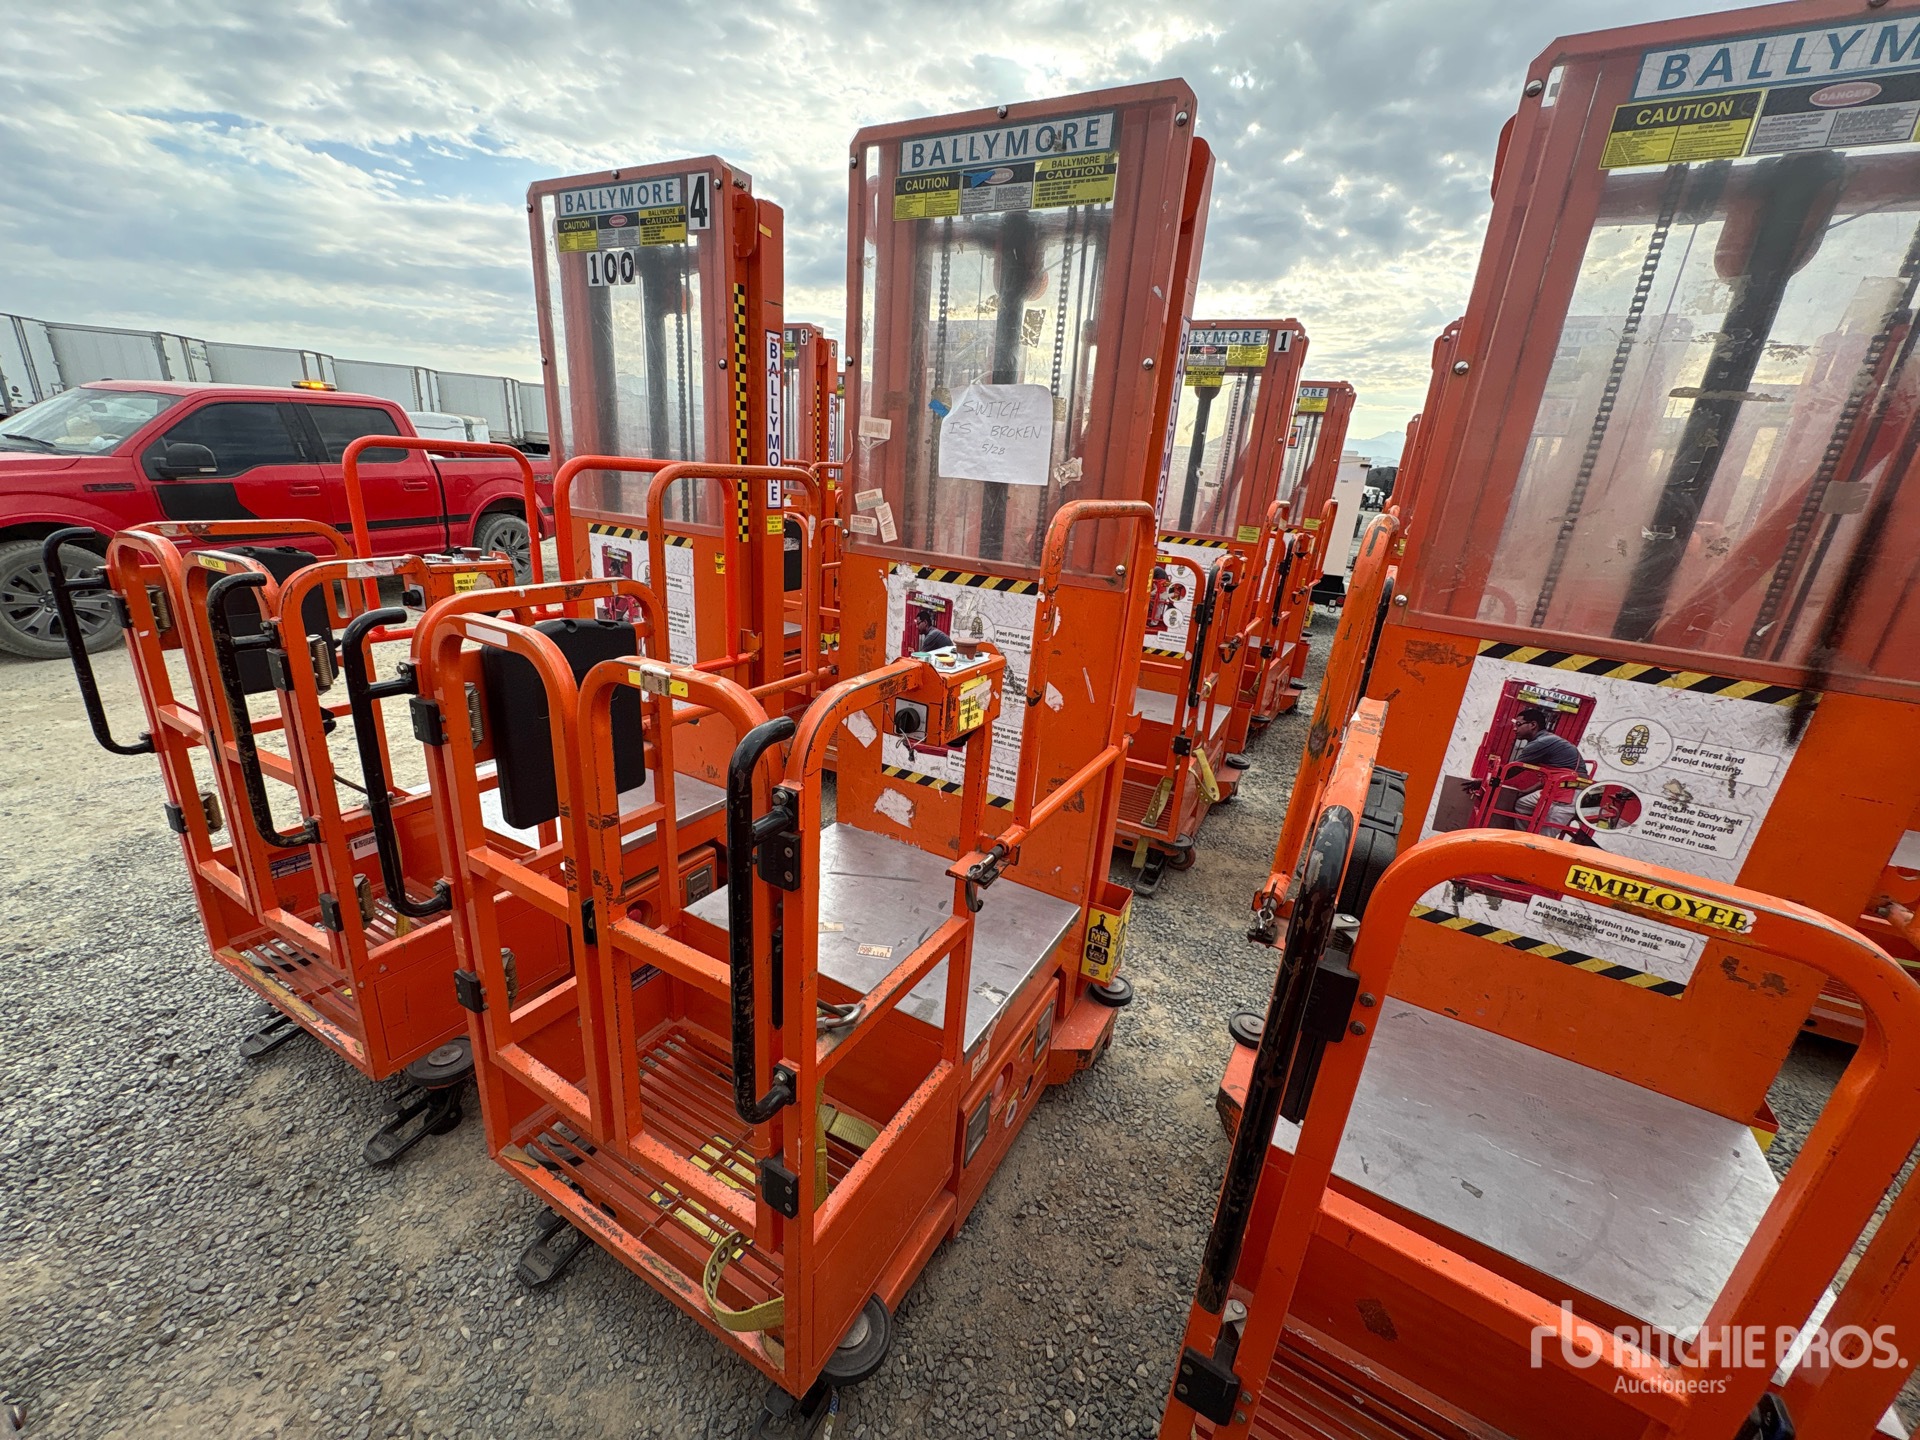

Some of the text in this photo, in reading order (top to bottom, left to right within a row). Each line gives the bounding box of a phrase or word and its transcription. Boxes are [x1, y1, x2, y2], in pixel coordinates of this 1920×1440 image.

[1819, 88, 1873, 101] DANGER
[1636, 100, 1735, 126] CAUTION
[911, 118, 1101, 169] BALLYMORE
[1051, 155, 1100, 169] BALLYMORE
[1046, 165, 1105, 180] CAUTION
[905, 176, 950, 192] CAUTION
[565, 181, 675, 214] BALLYMORE
[690, 175, 708, 228] 4
[645, 216, 680, 225] CAUTION
[648, 208, 676, 217] BALLYMORE
[563, 219, 590, 231] CAUTION
[590, 251, 635, 285] 100
[801, 329, 807, 344] 3
[1278, 331, 1289, 351] 1
[831, 342, 836, 357] 3
[962, 400, 1021, 418] SWITCH
[948, 421, 1042, 440] IS BROKEN
[981, 443, 1006, 455] 5/28
[205, 558, 219, 568] ONLY
[1008, 631, 1020, 639] First
[1526, 685, 1578, 703] BALLYMORE
[1618, 746, 1648, 755] FORM
[1675, 745, 1746, 765] Feet First and
[1671, 756, 1744, 776] avoid twisting.
[1652, 800, 1743, 826] Place the body belt
[1645, 820, 1717, 841] on yellow hook
[1648, 810, 1734, 835] and static lanyard
[1641, 829, 1718, 852] when not in use.
[1091, 927, 1110, 938] PLUG
[1532, 908, 1661, 952] and never stand on the rails.
[1535, 900, 1687, 949] Always work within the side rails
[1091, 932, 1109, 944] ME
